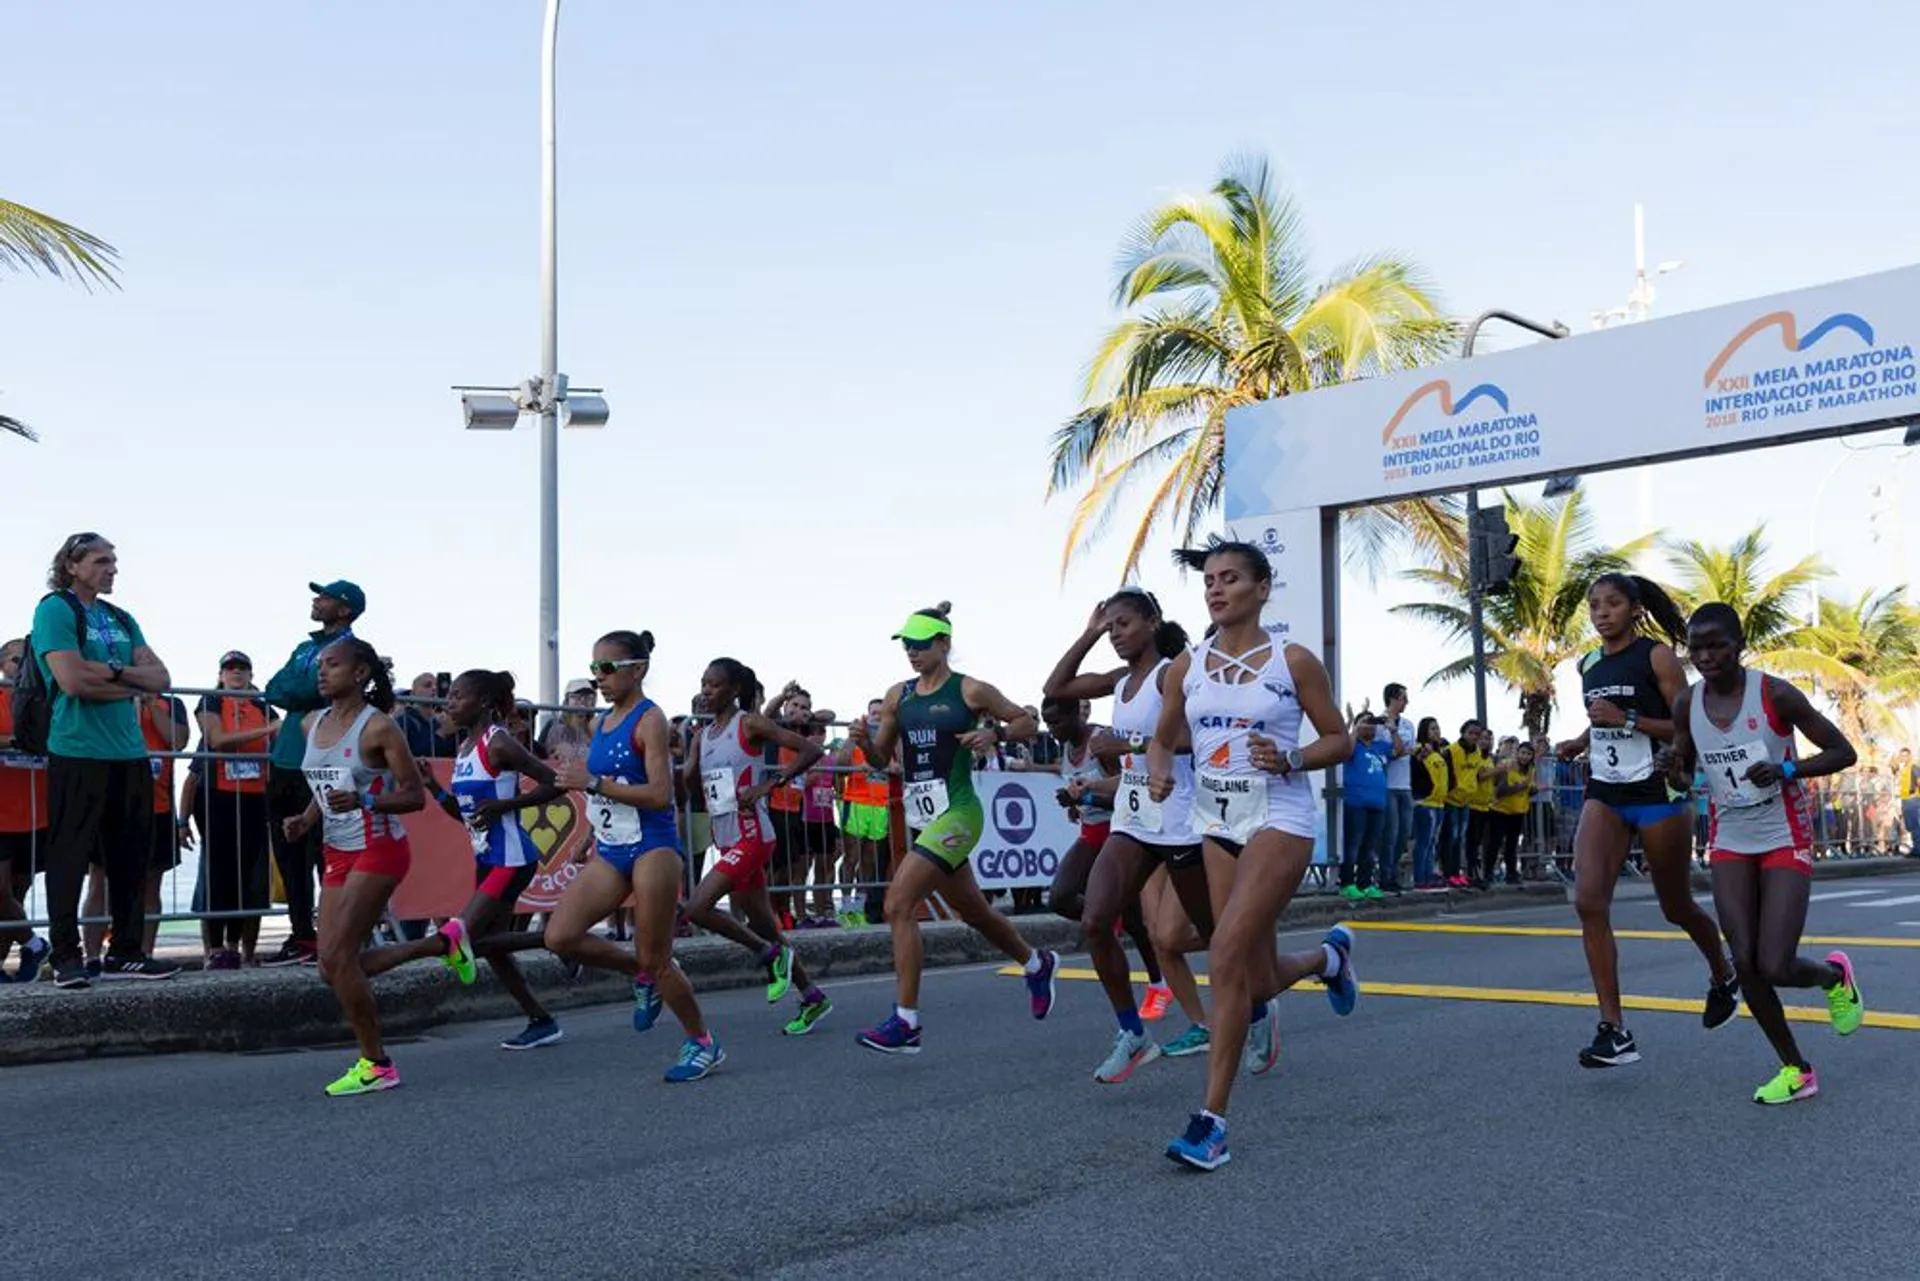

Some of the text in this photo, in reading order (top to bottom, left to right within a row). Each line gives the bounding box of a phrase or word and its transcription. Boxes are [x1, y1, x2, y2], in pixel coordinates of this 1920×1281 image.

[1718, 345, 1914, 393] XXII MEIA MARATONA
[1706, 364, 1916, 414] INTERNACIONAL DO RIO
[1742, 407, 1768, 423] RIO
[1774, 398, 1813, 416] HALF
[1818, 382, 1917, 410] MARATHON
[1392, 412, 1538, 450] XXII MEIA MARATONA
[1383, 430, 1540, 468] INTERNACIONAL DO RIO
[1411, 463, 1432, 477] RIO
[1434, 458, 1464, 473] HALF
[1468, 446, 1540, 468] MARATHON
[1200, 716, 1266, 731] CAIXA
[908, 730, 936, 745] RUN
[1606, 744, 1619, 767] 3
[1704, 748, 1748, 765] ESTHER
[1724, 766, 1738, 789] 1
[916, 796, 934, 816] 10
[1129, 790, 1140, 812] 6
[1216, 798, 1229, 822] 7
[601, 808, 612, 829] 2
[978, 848, 1058, 878] GLOBO
